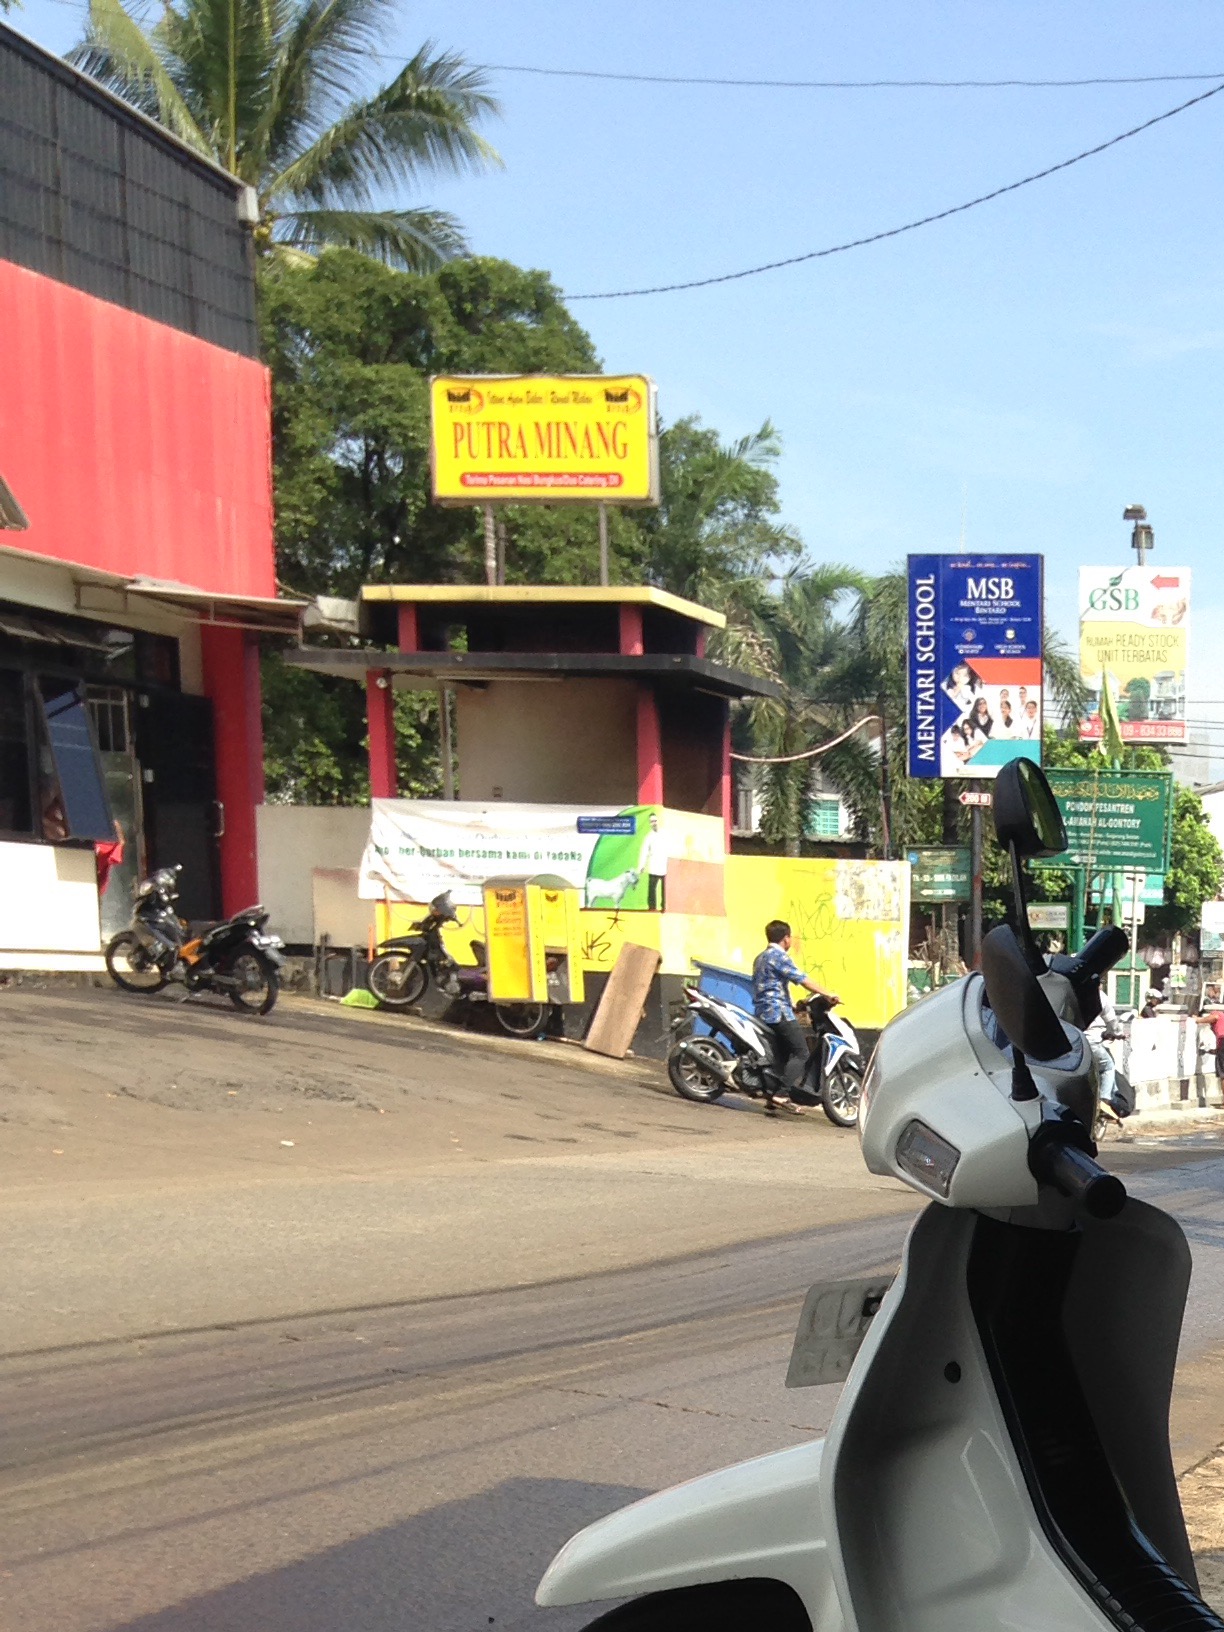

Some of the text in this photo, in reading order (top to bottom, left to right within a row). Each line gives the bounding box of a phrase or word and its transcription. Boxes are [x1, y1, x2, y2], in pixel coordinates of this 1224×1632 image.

[453, 421, 629, 459] PUTRA MINANG
[967, 577, 1014, 599] MSB
[1089, 587, 1140, 611] GSB
[916, 573, 936, 663] SCHOOL
[1116, 634, 1146, 647] READY
[1148, 634, 1180, 647] STOCK
[1097, 649, 1168, 663] UNIT TERBATAS
[917, 669, 936, 761] MENTARI
[1095, 802, 1135, 814] PESANTREN
[458, 847, 503, 860] bersama
